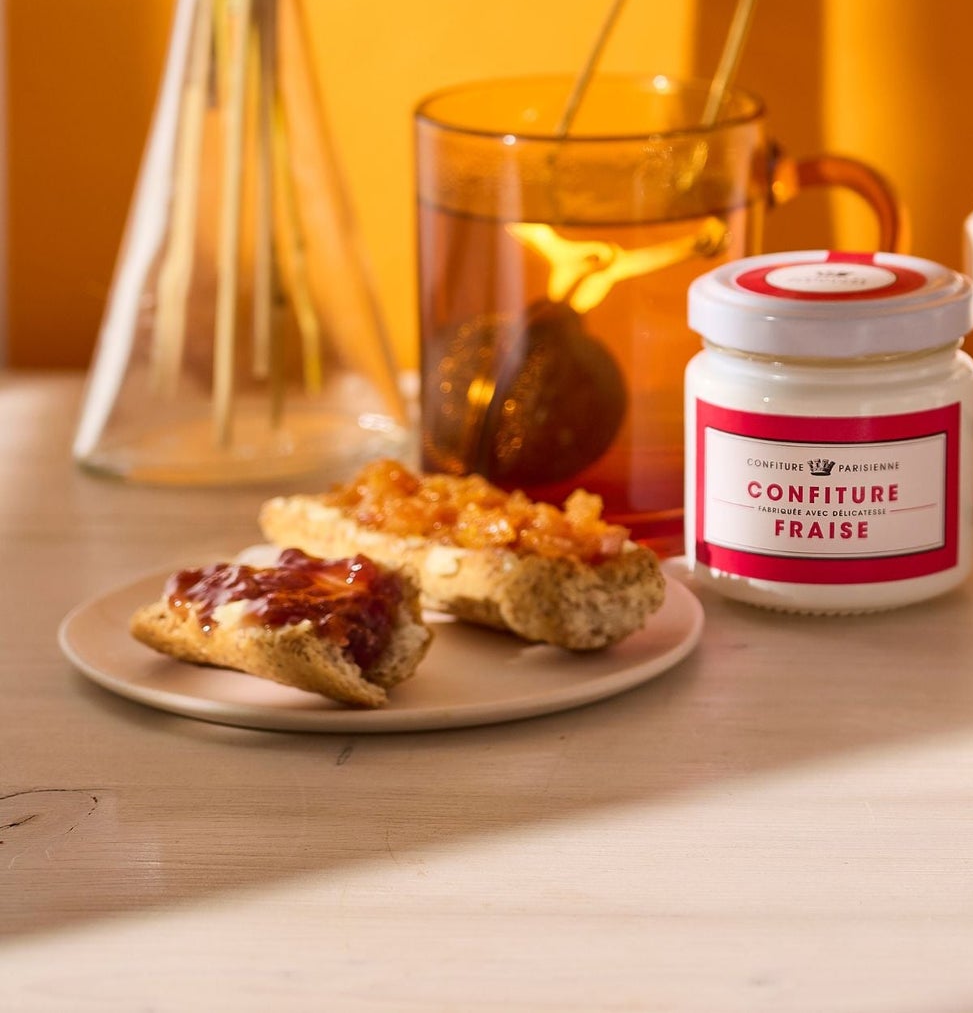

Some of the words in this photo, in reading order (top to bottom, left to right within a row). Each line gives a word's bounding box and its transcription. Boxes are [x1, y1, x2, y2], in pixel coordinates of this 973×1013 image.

[747, 458, 804, 471] CONFITURE
[839, 462, 899, 472] PARISIENNE
[748, 481, 898, 504] CONFITURE
[758, 506, 802, 516] FABRIQUÉE
[833, 508, 886, 517] DÉLICATESSE
[775, 519, 868, 538] FRAISE
